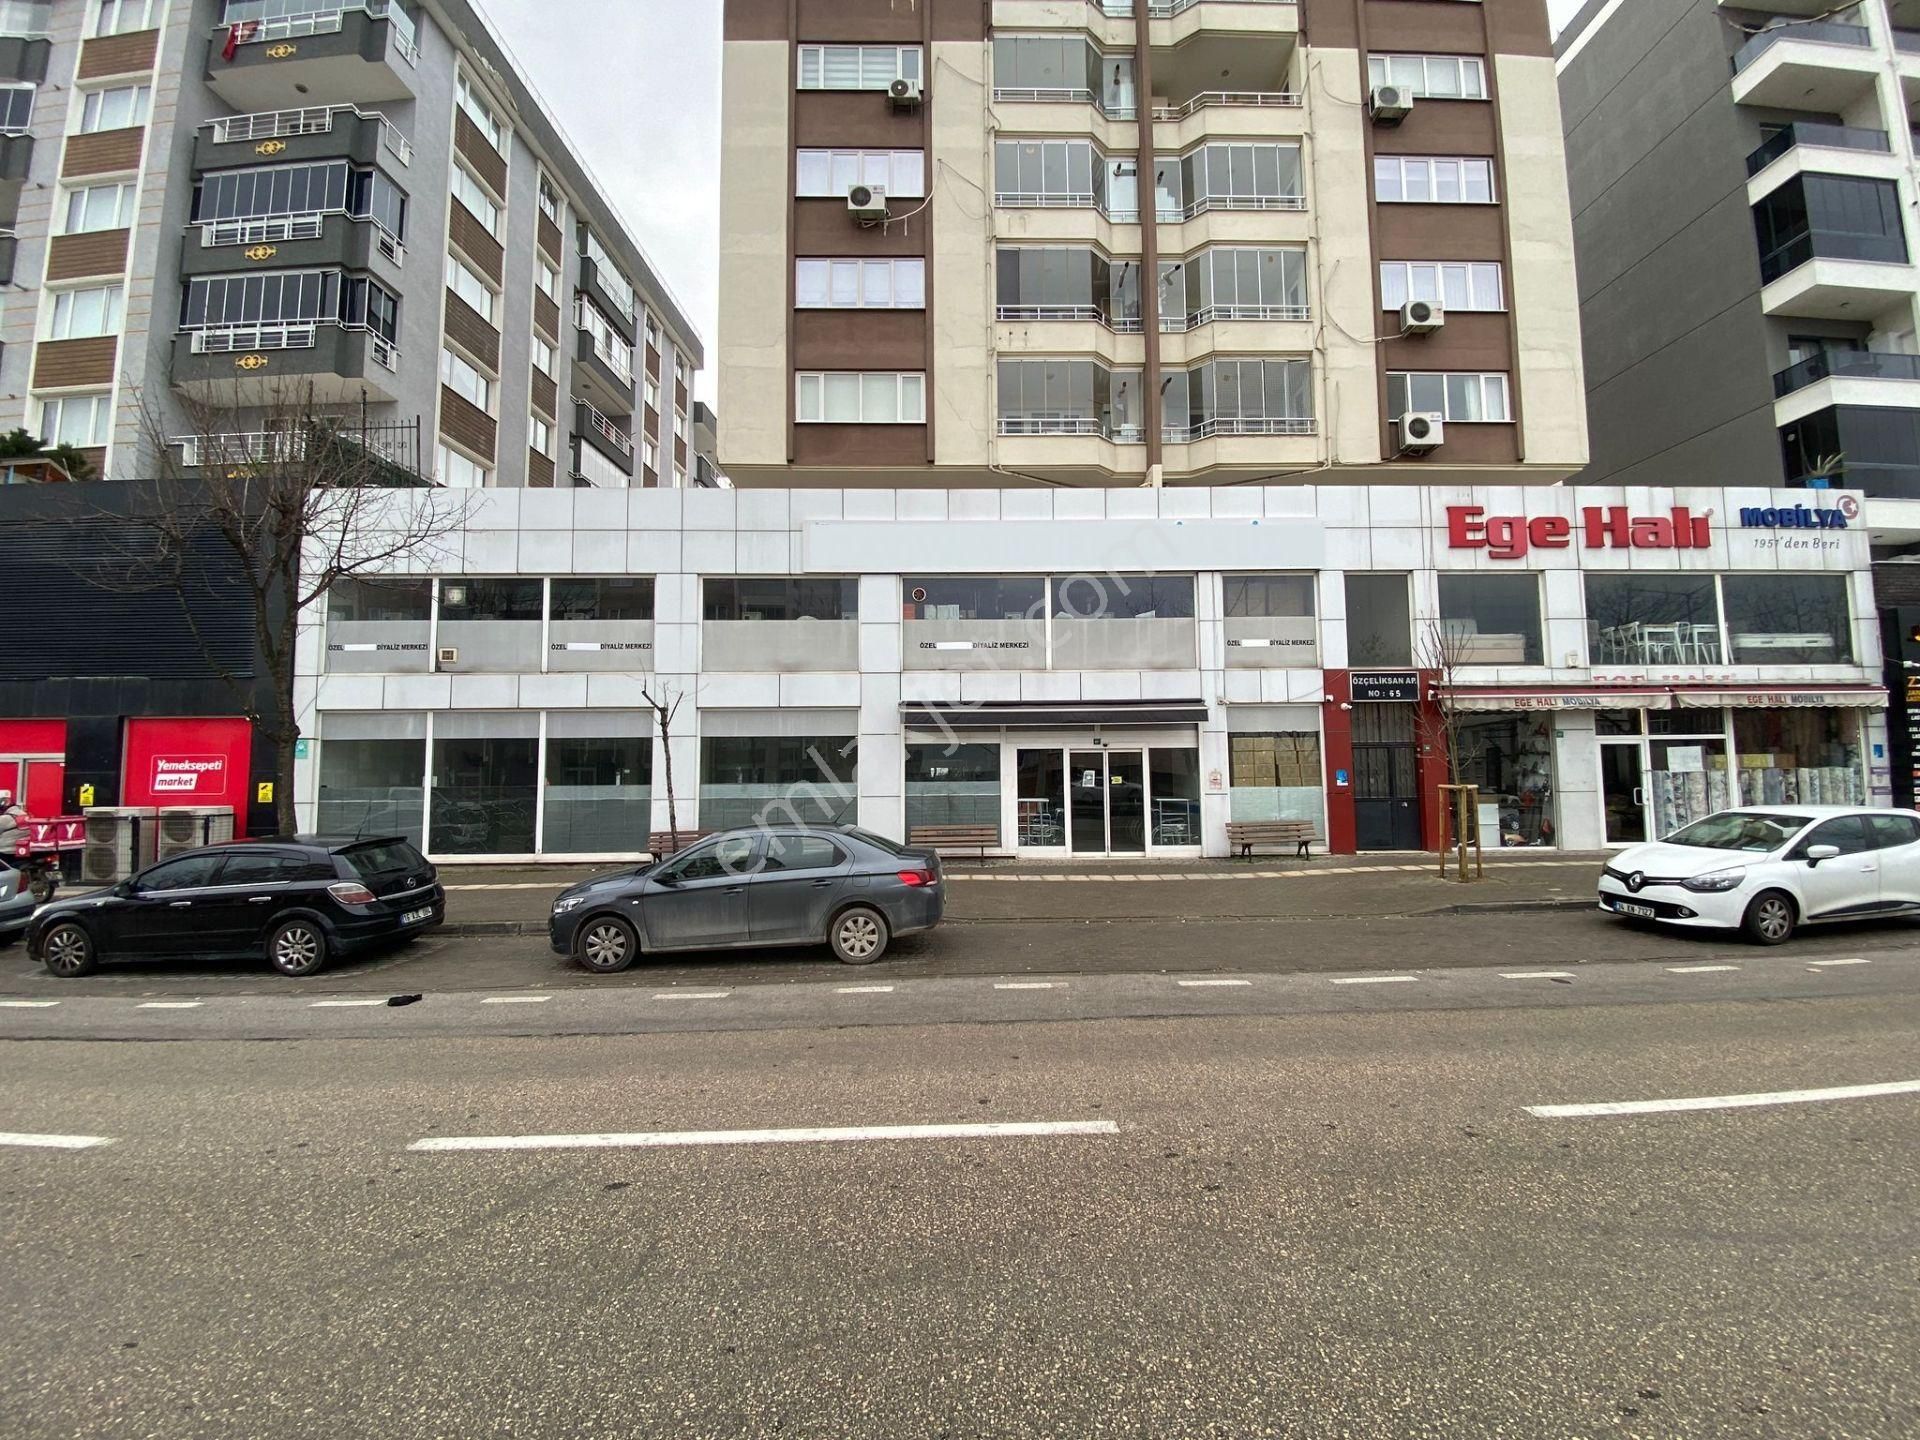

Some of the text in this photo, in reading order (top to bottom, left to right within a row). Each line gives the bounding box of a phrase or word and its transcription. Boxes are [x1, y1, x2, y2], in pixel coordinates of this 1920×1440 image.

[1739, 503, 1848, 528] MOBİLYA
[1447, 506, 1712, 559] Ege Halı
[1812, 536, 1840, 550] Beri
[600, 642, 624, 650] DİYALİZ
[625, 642, 652, 650] MERKEZİ
[919, 641, 1029, 649] ÖZEL DİYALİZ MERKEZİ
[1270, 638, 1290, 646] DİYALİZ
[1291, 638, 1314, 646] MERKEZİ
[1352, 676, 1403, 686] ÖZÇELİKSAN
[1514, 698, 1532, 707] EGE
[1747, 695, 1764, 704] EGE
[157, 759, 222, 771] Yemeksepeti
[157, 775, 194, 788] market
